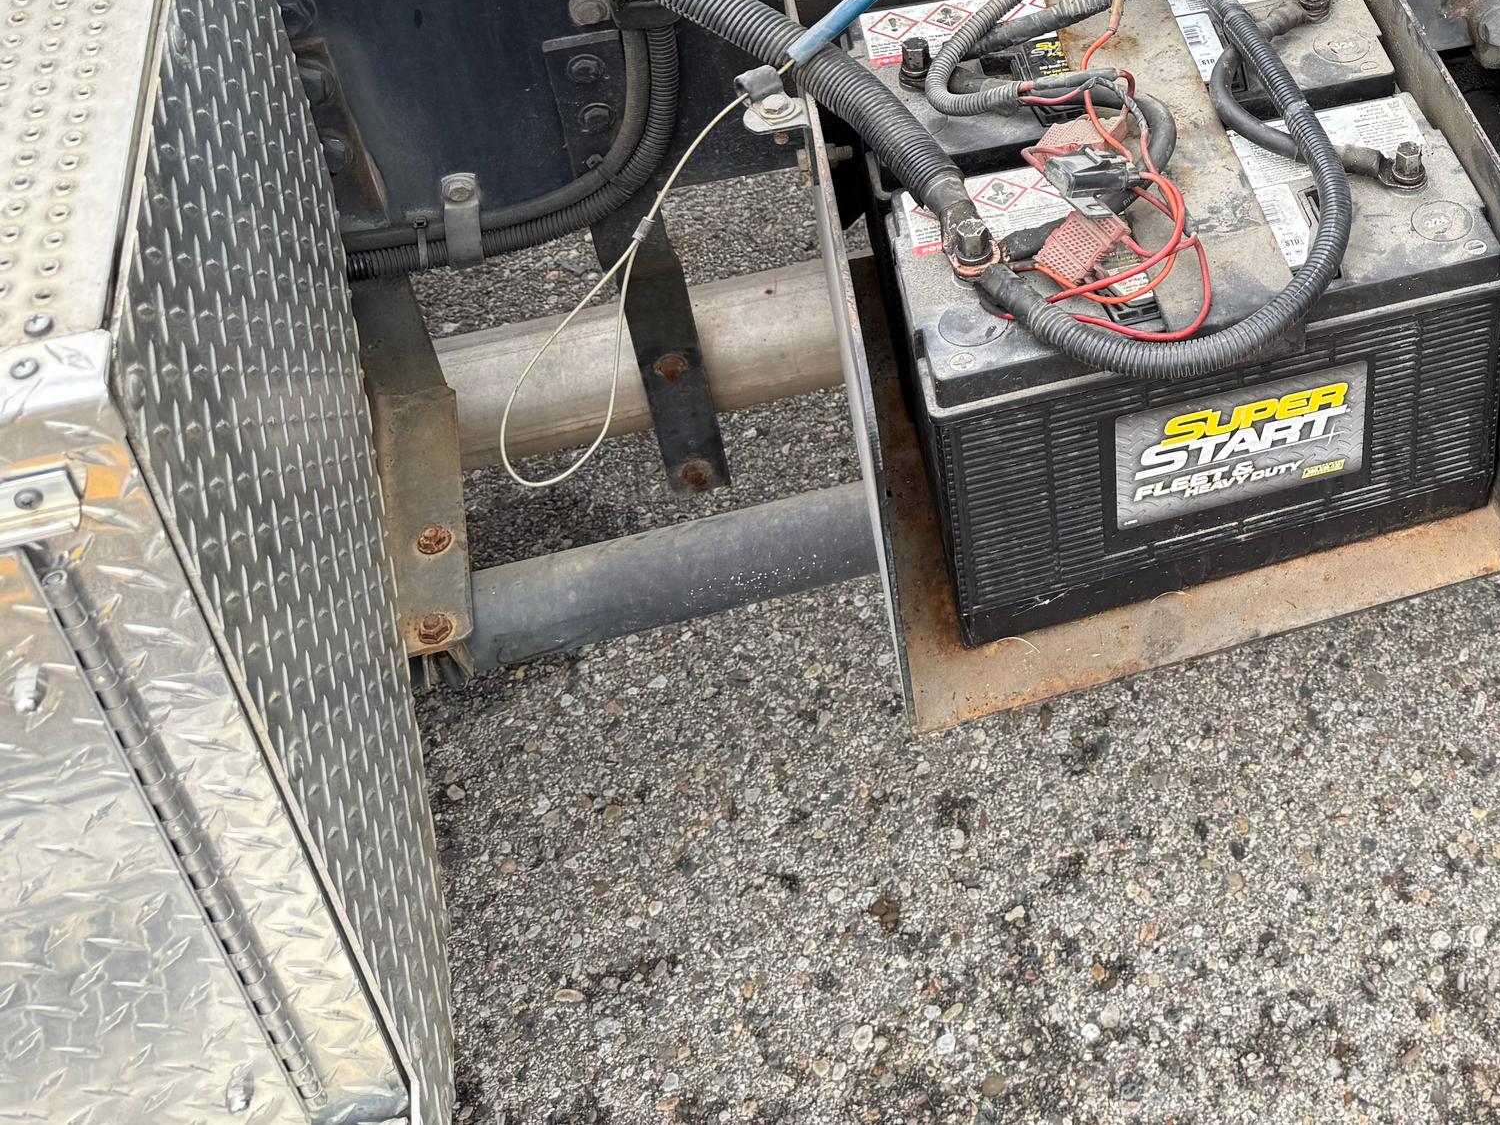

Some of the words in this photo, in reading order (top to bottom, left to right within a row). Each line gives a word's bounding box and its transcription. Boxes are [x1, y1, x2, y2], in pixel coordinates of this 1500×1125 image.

[1161, 382, 1349, 447] SUPER
[1134, 404, 1350, 481] START
[1133, 466, 1230, 503] FLEET
[1231, 459, 1255, 477] &
[1183, 472, 1250, 499] HEAVY
[1250, 458, 1305, 483] DUTY
